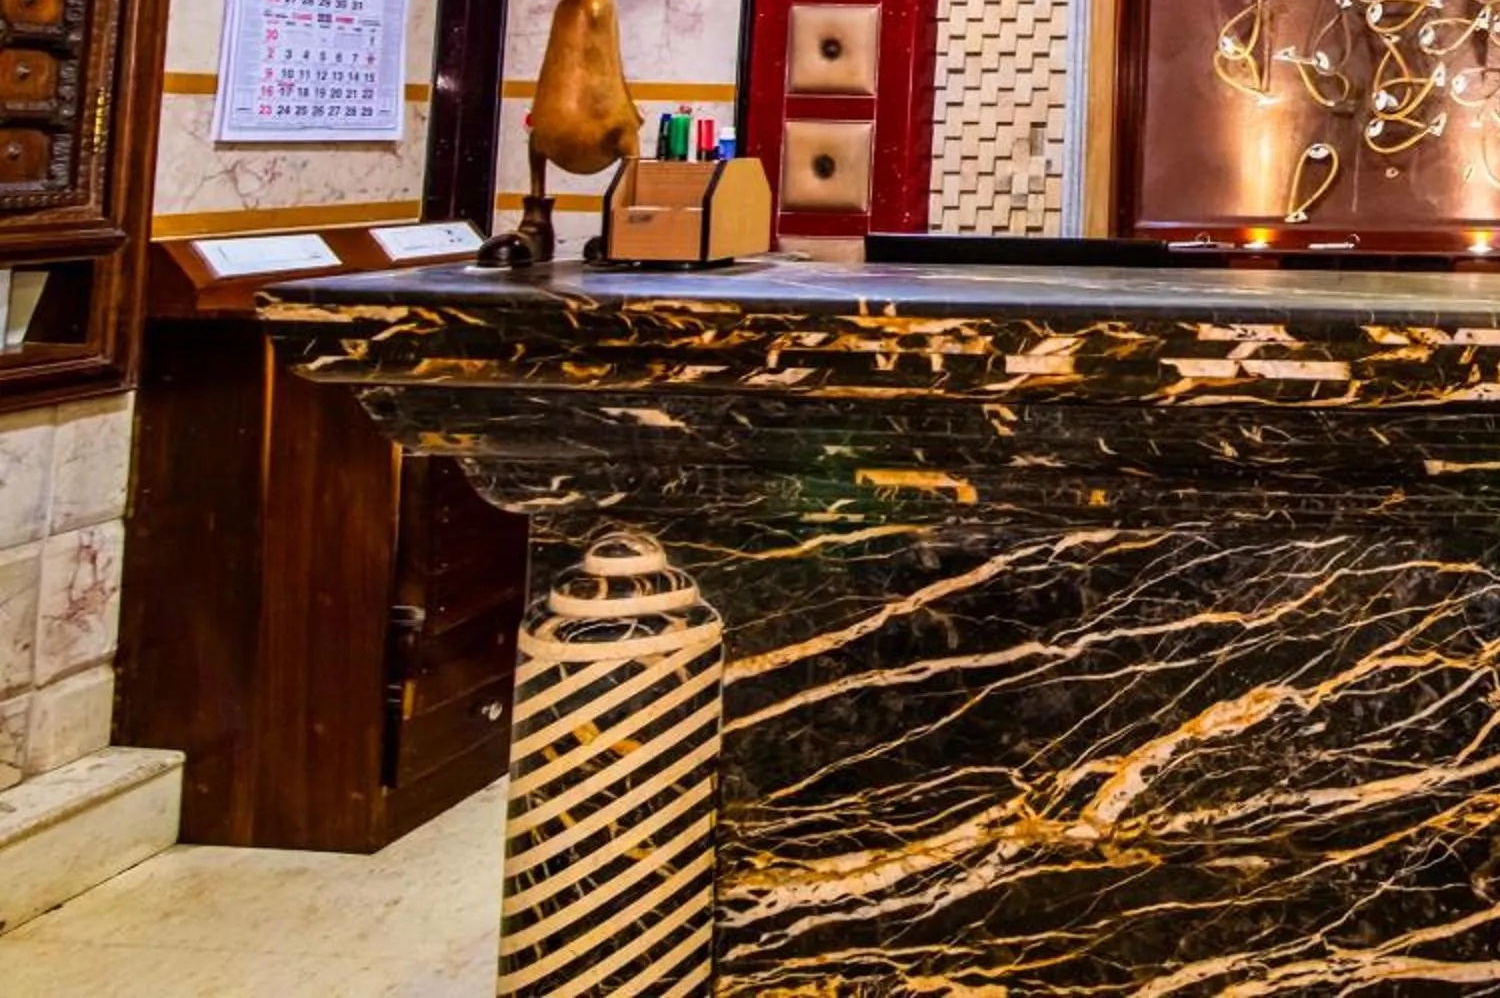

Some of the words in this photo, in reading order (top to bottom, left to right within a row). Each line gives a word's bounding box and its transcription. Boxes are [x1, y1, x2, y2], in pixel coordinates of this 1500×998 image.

[336, 0, 347, 9] 30
[352, 2, 363, 10] 31
[286, 50, 292, 59] 3
[304, 50, 309, 59] 4
[320, 51, 326, 61] 5
[336, 52, 342, 62] 6
[282, 69, 294, 78] 10
[300, 70, 310, 79] 11
[317, 71, 327, 80] 12
[332, 72, 343, 81] 13
[350, 72, 359, 81] 14
[365, 73, 374, 82] 15
[262, 86, 274, 96] 16
[280, 87, 293, 96] 17
[298, 88, 308, 96] 18
[316, 88, 326, 98] 19
[330, 89, 342, 98] 20
[346, 90, 357, 98] 21
[362, 90, 373, 99] 22
[259, 105, 272, 114] 23
[277, 106, 290, 114] 24
[295, 106, 307, 115] 25
[312, 106, 324, 116] 26
[328, 106, 341, 116] 27
[346, 106, 356, 116] 28
[361, 107, 372, 116] 29
